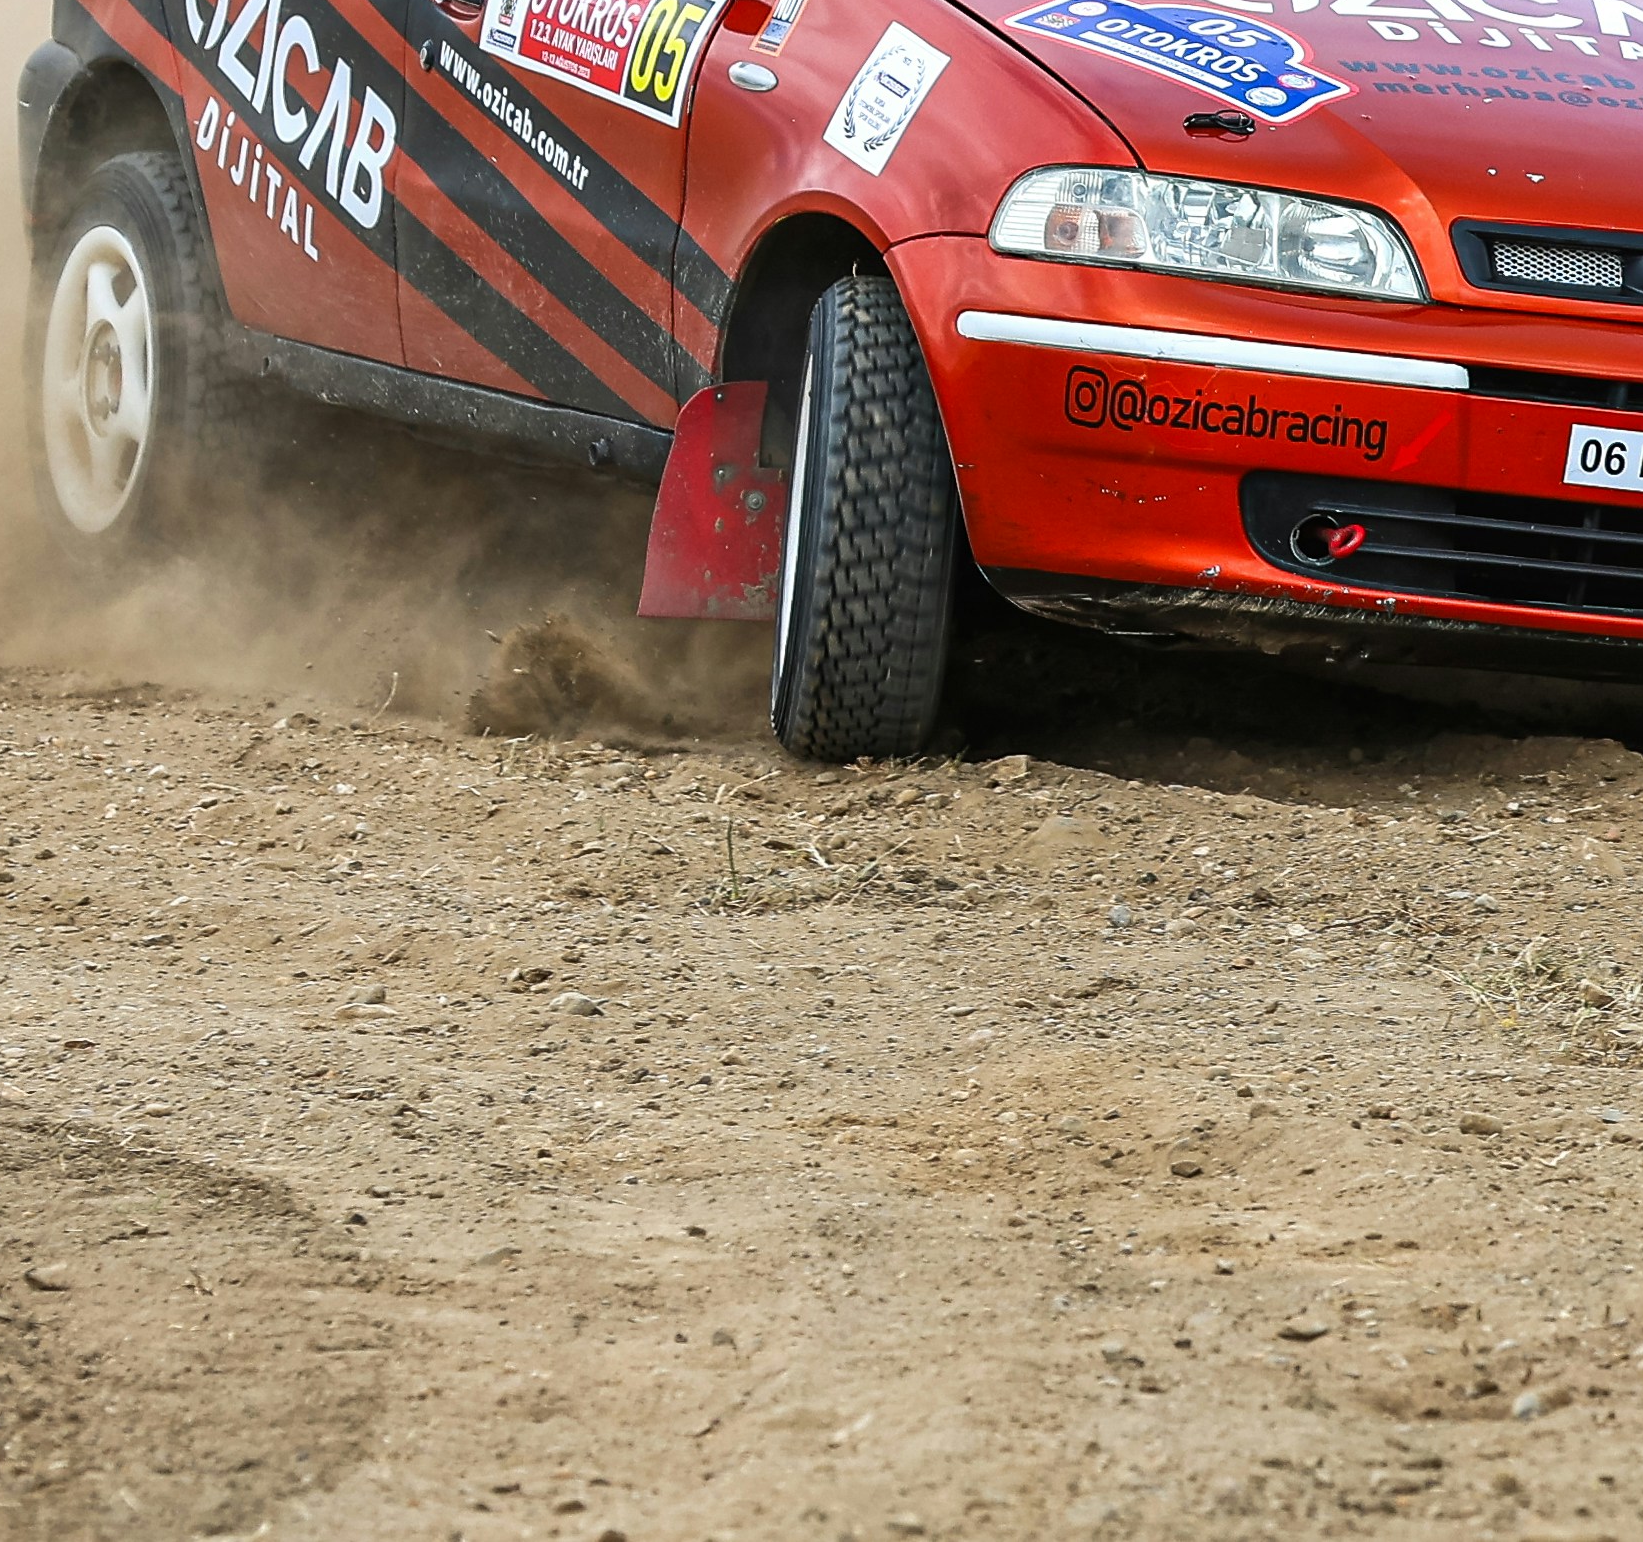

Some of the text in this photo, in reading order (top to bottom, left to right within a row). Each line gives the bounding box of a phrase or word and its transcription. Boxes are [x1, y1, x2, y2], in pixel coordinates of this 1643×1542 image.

[551, 28, 576, 54] AYAK
[575, 36, 619, 71] YARIŞLARI
[1095, 18, 1269, 83] OTOKROS
[1187, 18, 1271, 49] 05
[440, 40, 590, 190] www.ozicab.com.tr
[1109, 379, 1388, 462] @ozicabracing
[1579, 438, 1628, 476] 06
